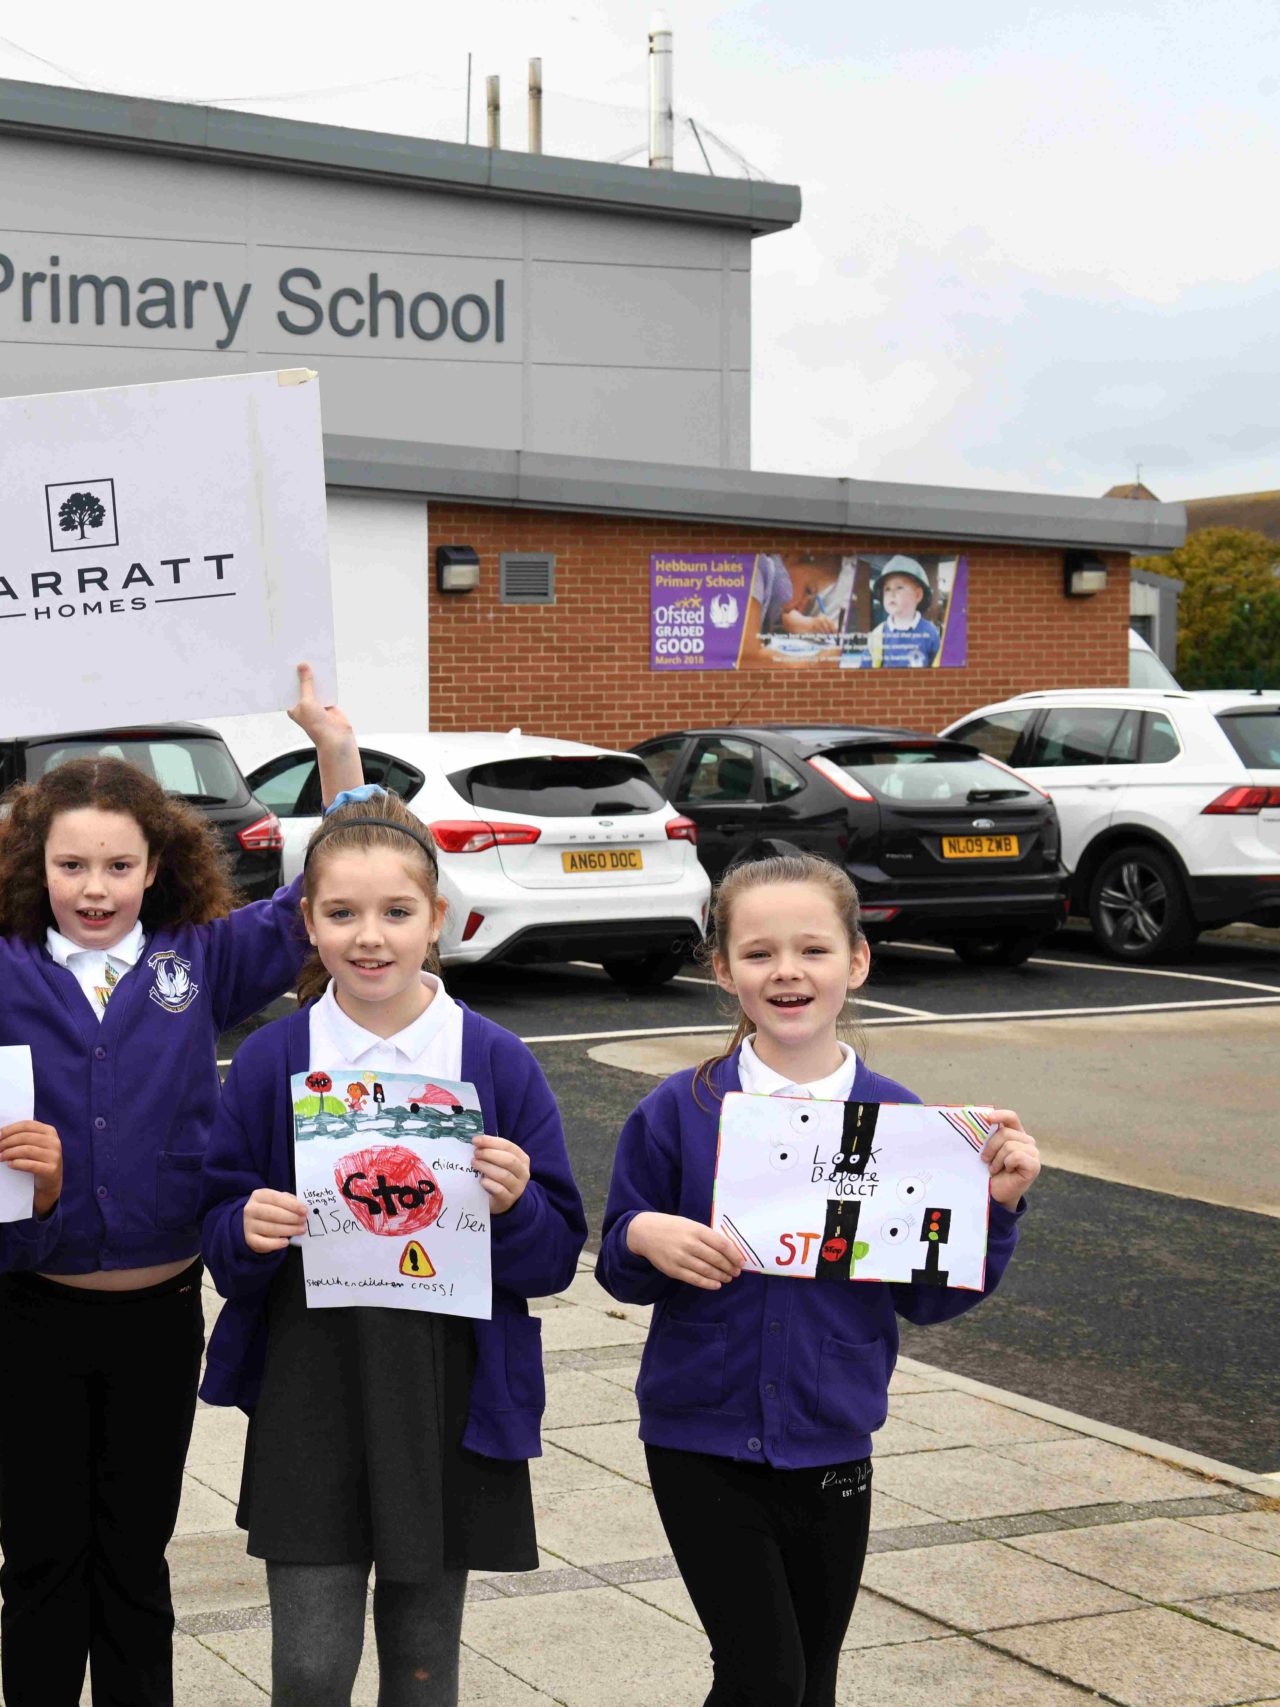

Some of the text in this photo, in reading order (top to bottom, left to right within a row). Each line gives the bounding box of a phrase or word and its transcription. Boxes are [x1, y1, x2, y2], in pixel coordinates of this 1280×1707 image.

[277, 267, 505, 343] School
[655, 560, 743, 573] Hebburn Lakes
[655, 575, 745, 591] Primary School
[33, 597, 147, 621] HOMES
[655, 605, 705, 624] Ofsted
[655, 626, 705, 637] GRADED
[655, 638, 705, 654] GOOD
[655, 656, 705, 665] March 2018
[948, 837, 1012, 854] NL09 ZWB
[570, 851, 637, 870] AN60 DOC
